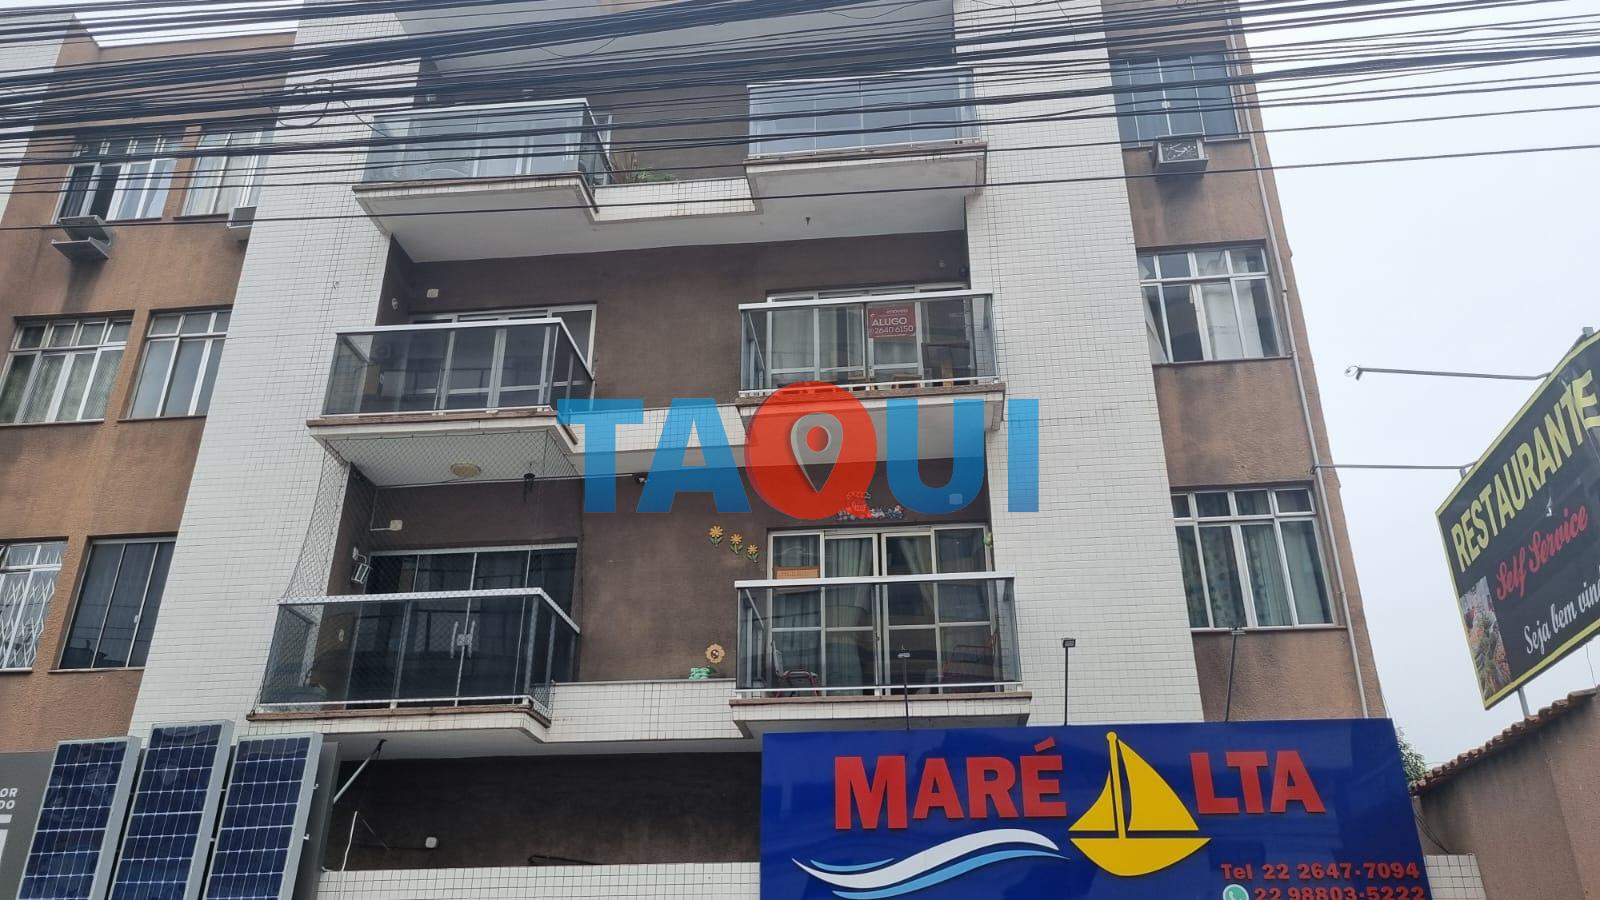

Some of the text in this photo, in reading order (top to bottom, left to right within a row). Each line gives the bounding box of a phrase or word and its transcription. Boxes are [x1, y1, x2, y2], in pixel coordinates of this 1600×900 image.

[871, 317, 908, 327] ALUGO
[895, 325, 914, 333] 6150
[1451, 369, 1600, 573] RESTAURANTE
[1496, 505, 1588, 601] Self Service
[1523, 565, 1600, 654] Seja bem vin
[834, 736, 1068, 830] MARÉ
[1221, 863, 1254, 880] Tel
[1262, 864, 1290, 880] 22
[1254, 887, 1281, 900] 22
